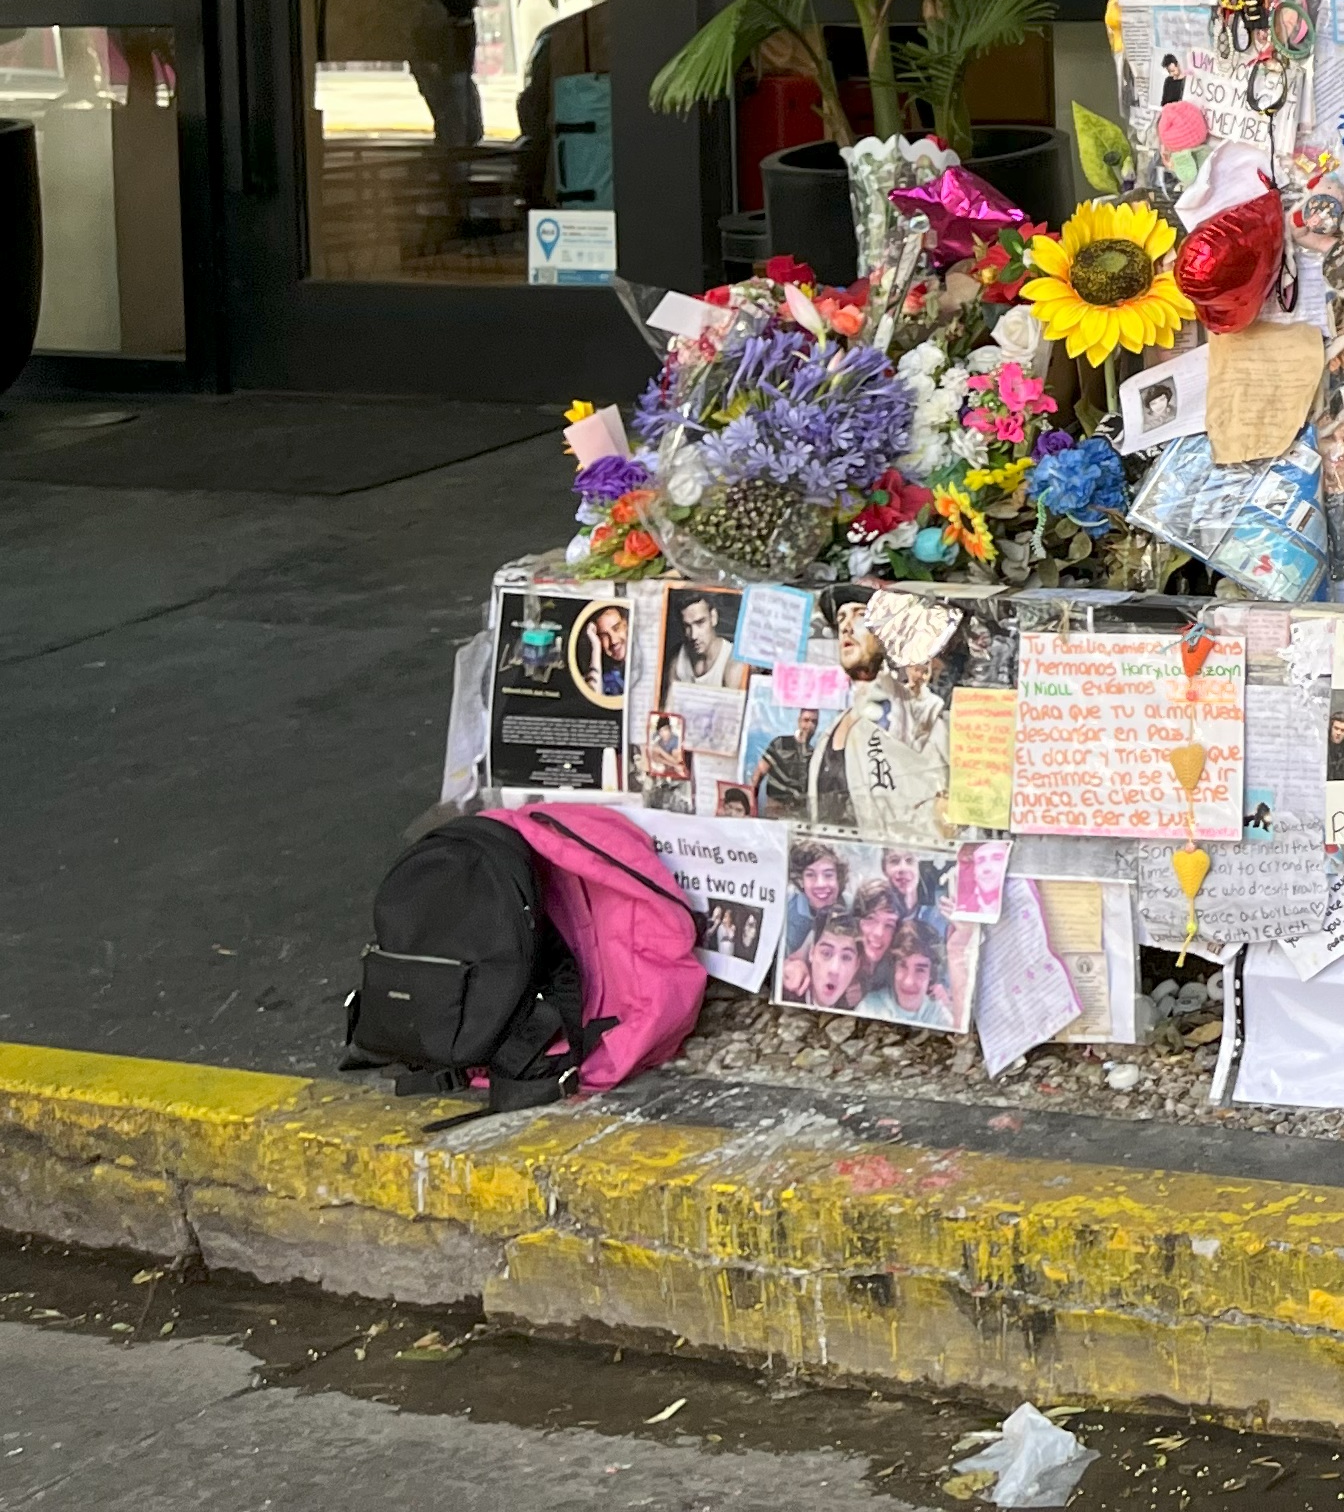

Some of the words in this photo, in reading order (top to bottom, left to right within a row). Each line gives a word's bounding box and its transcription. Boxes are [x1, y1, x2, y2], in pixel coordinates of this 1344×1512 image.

[1205, 82, 1226, 104] SO
[1036, 658, 1117, 676] hermanos
[1114, 727, 1138, 742] en
[1042, 747, 1093, 766] dolor
[1110, 771, 1133, 787] no
[1139, 769, 1163, 786] se
[1218, 766, 1238, 783] ir
[1011, 809, 1037, 826] un
[1129, 809, 1151, 827] de
[678, 838, 724, 864] living
[727, 848, 758, 864] one
[706, 874, 735, 894] two
[740, 879, 755, 898] of
[759, 887, 776, 902] us
